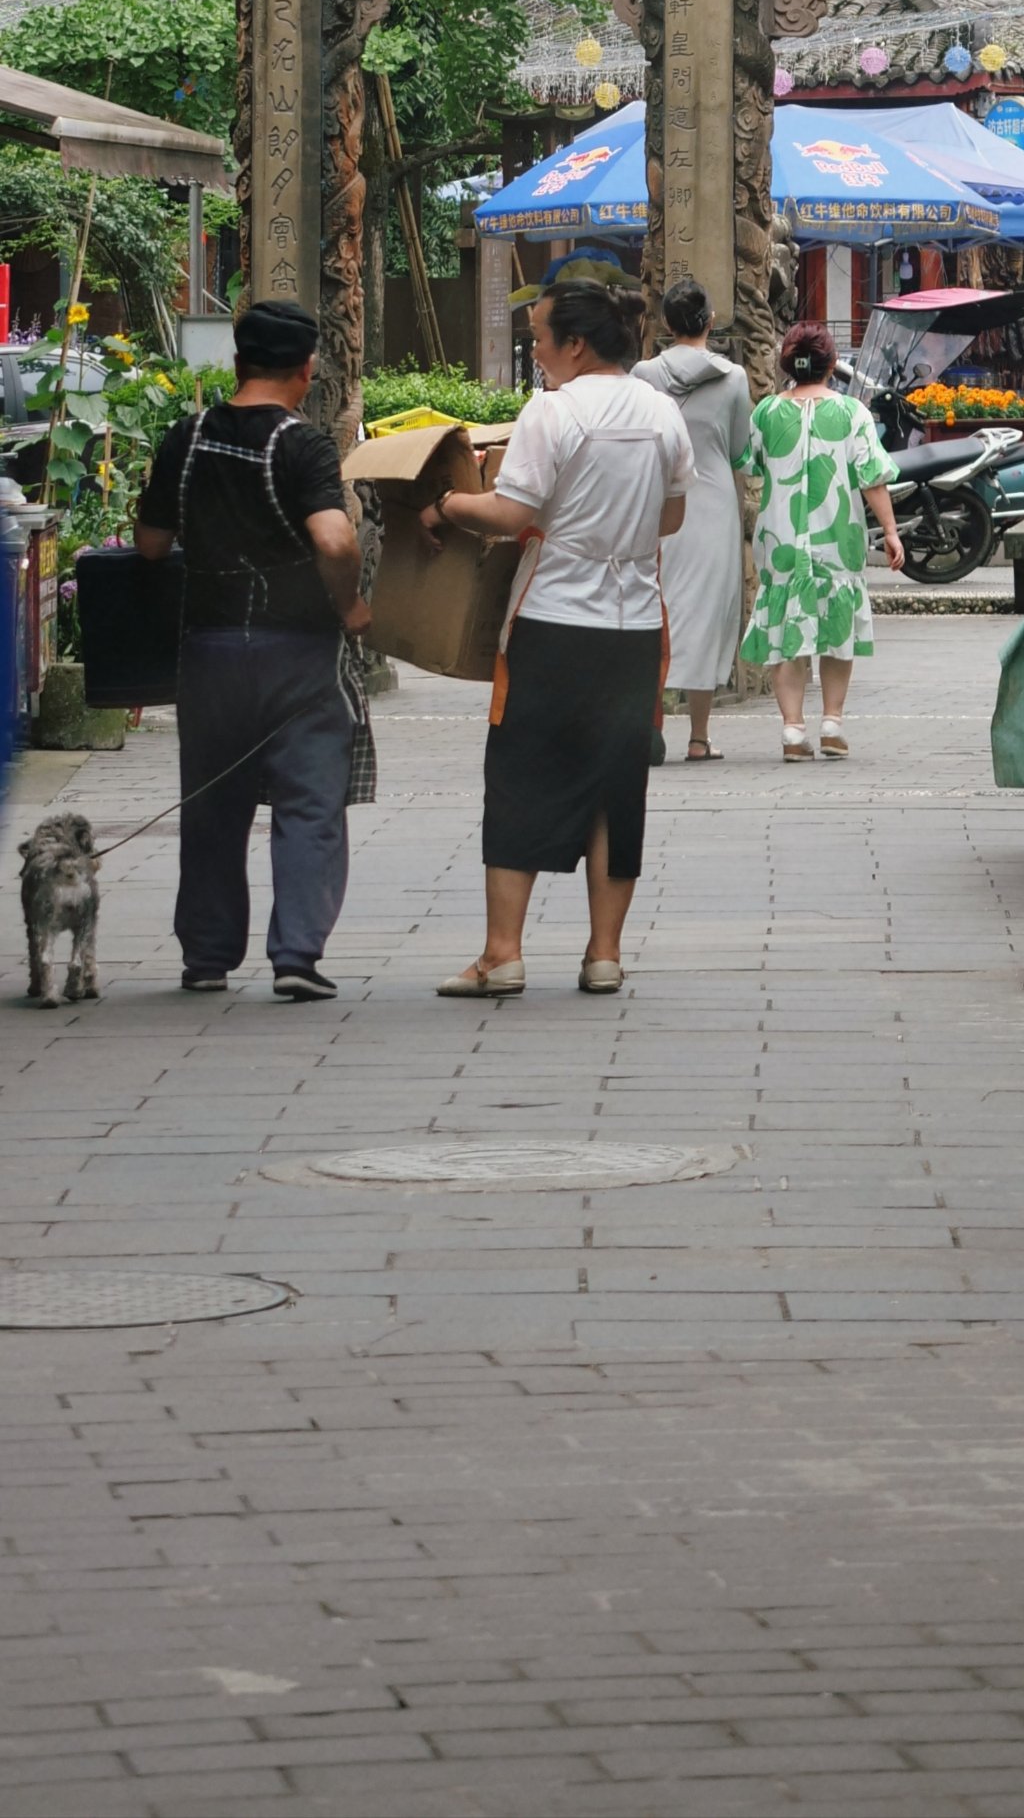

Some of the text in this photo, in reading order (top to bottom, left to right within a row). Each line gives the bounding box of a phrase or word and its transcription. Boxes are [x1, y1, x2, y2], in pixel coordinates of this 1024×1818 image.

[801, 203, 952, 220] 红牛维他命饮料有限公司
